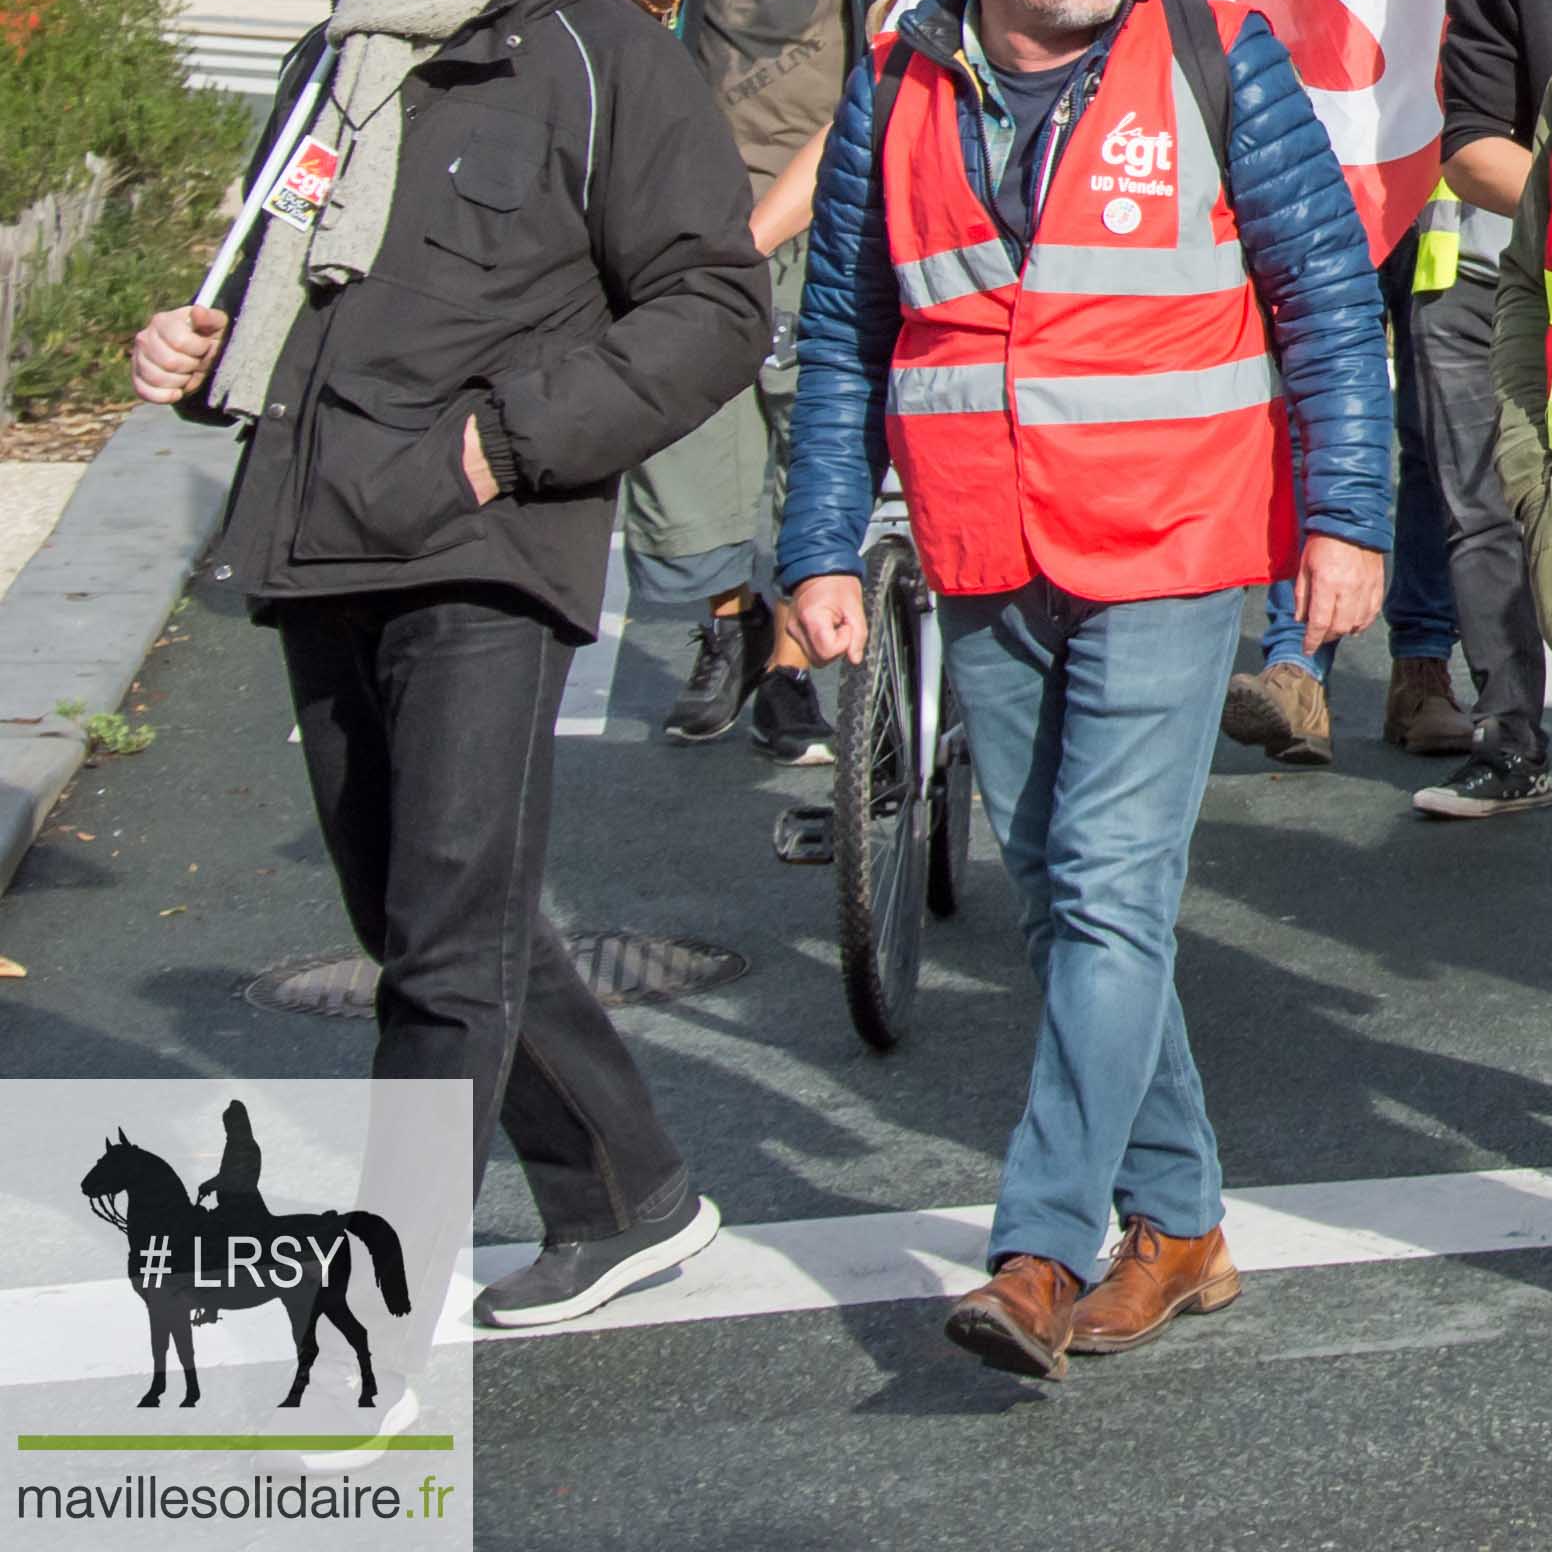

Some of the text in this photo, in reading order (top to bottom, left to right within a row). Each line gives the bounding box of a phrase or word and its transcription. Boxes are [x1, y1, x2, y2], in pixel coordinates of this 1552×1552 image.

[1101, 131, 1173, 177] cgt
[1091, 175, 1174, 196] UD Vendée
